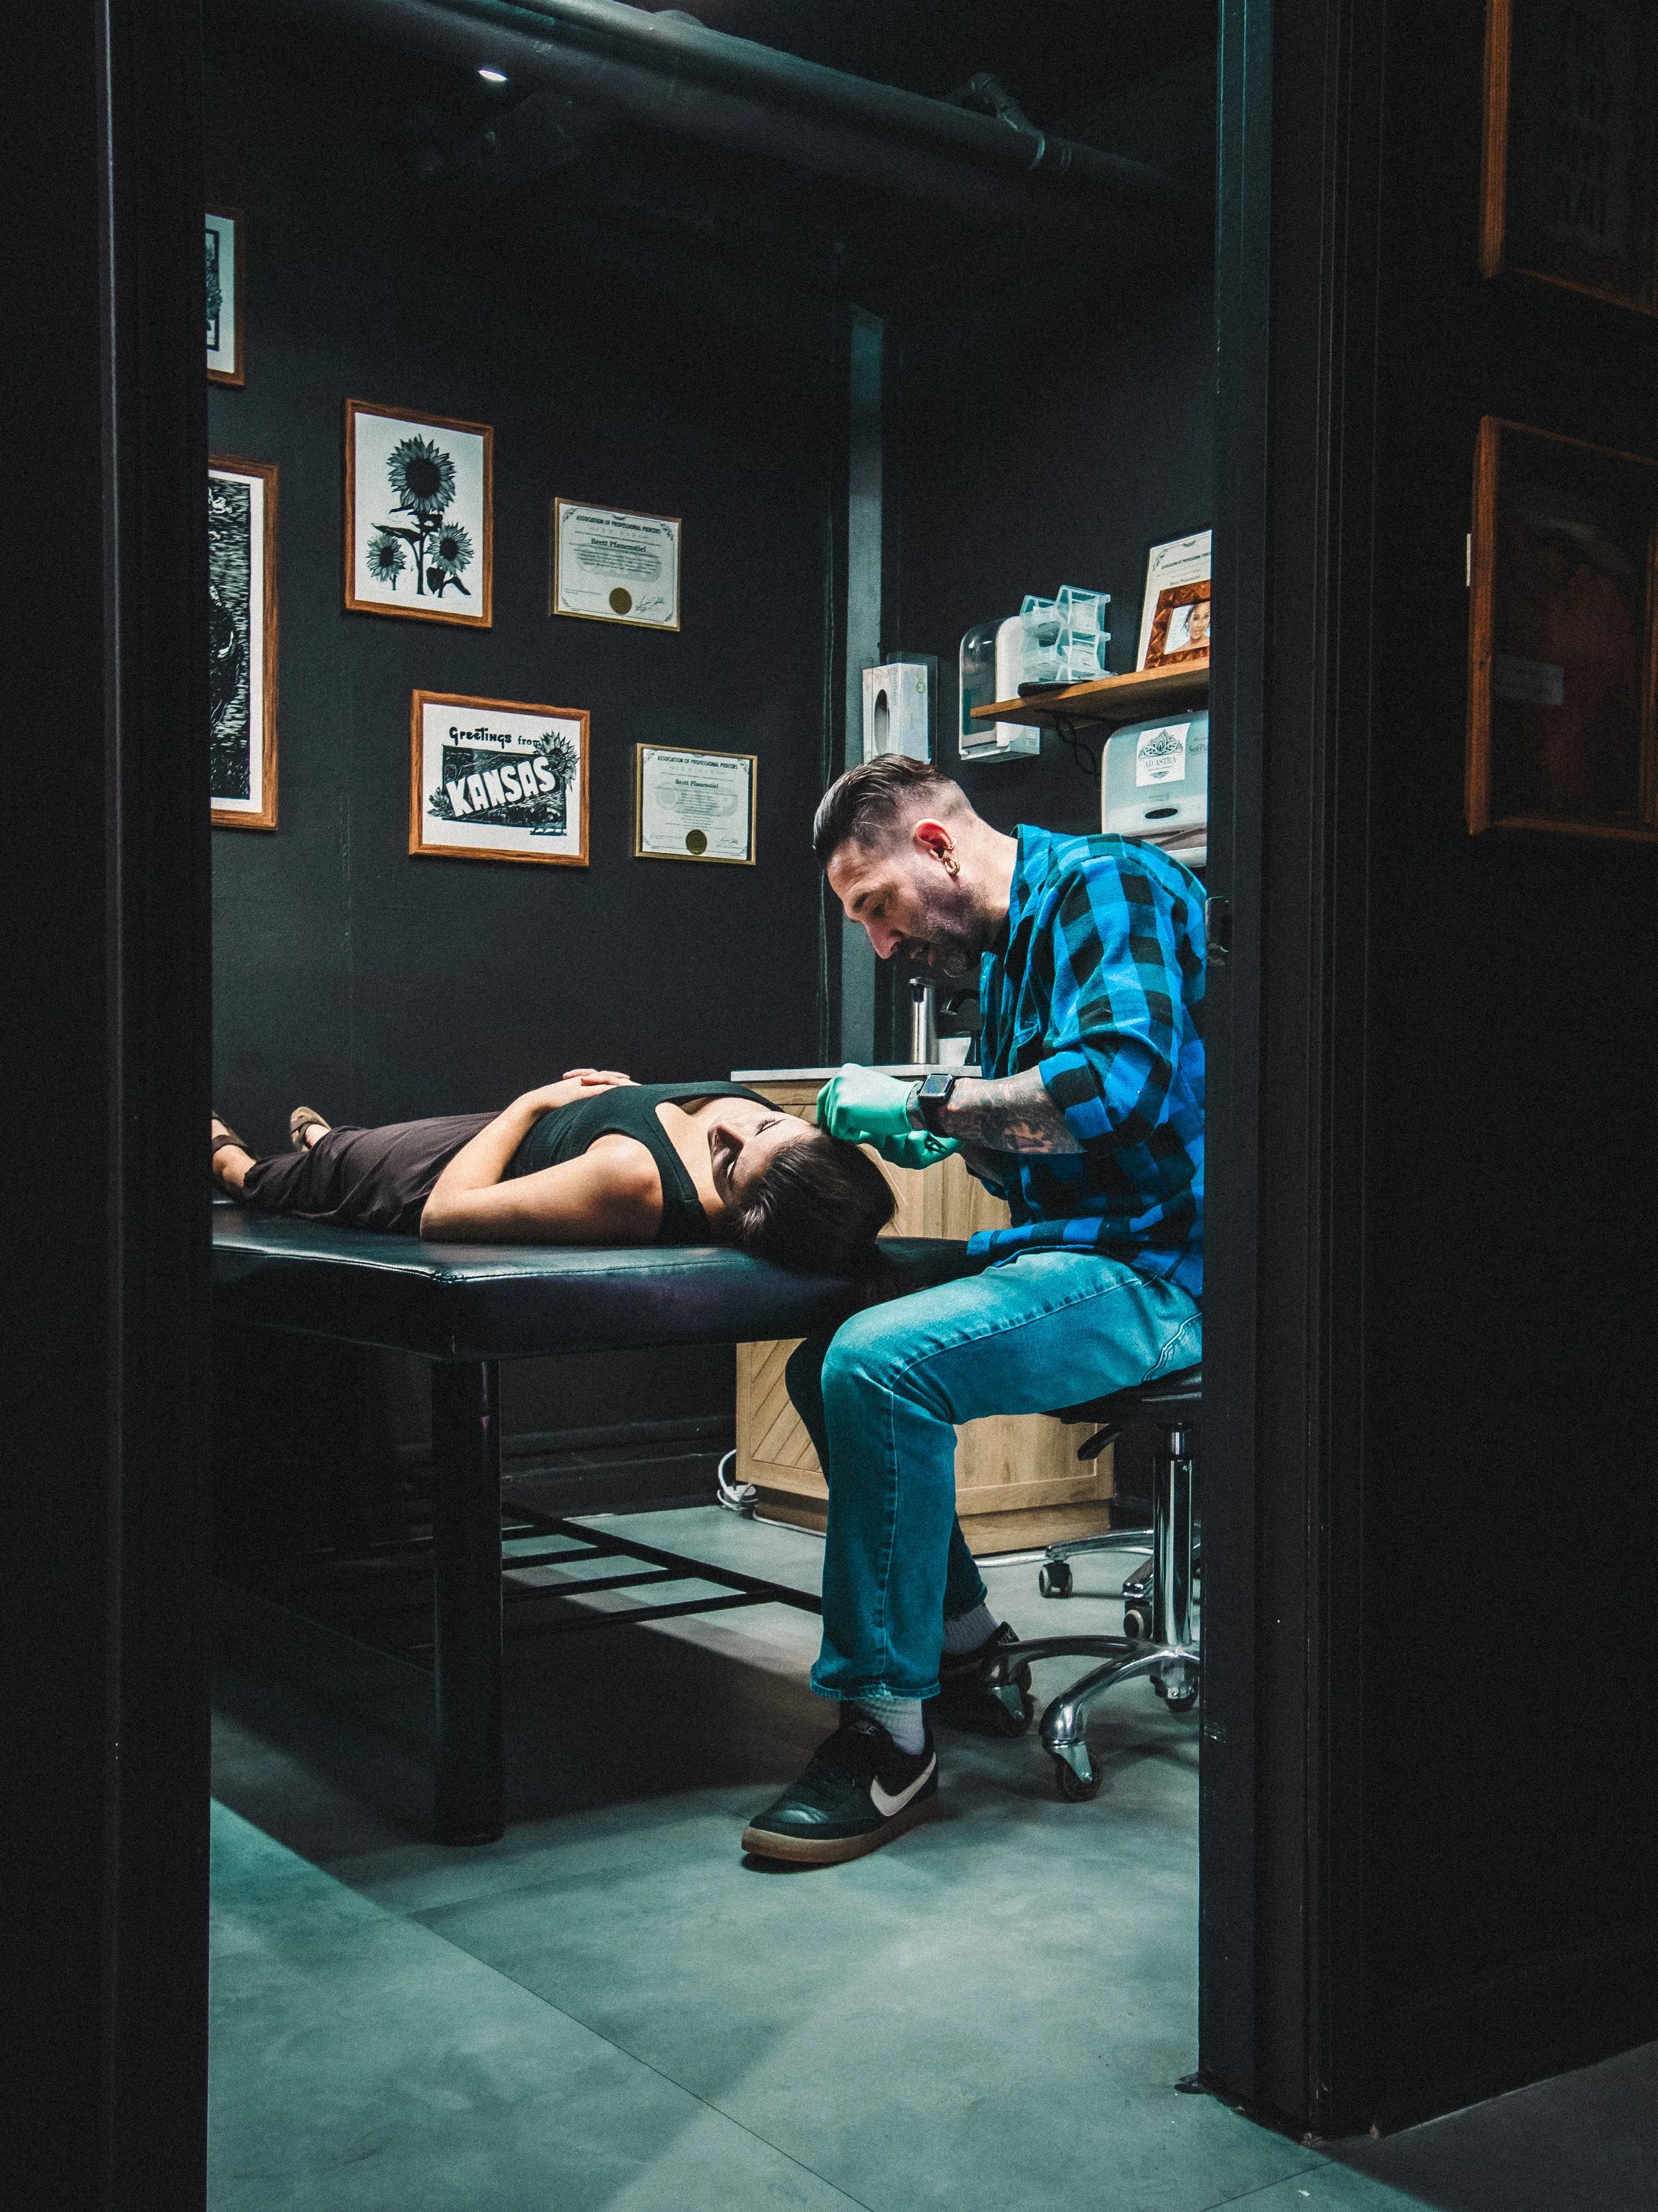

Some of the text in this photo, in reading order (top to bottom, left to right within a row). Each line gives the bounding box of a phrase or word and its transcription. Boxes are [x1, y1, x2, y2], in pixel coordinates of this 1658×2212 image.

[449, 726, 541, 749] Greetings from
[446, 756, 556, 817] KANSAS
